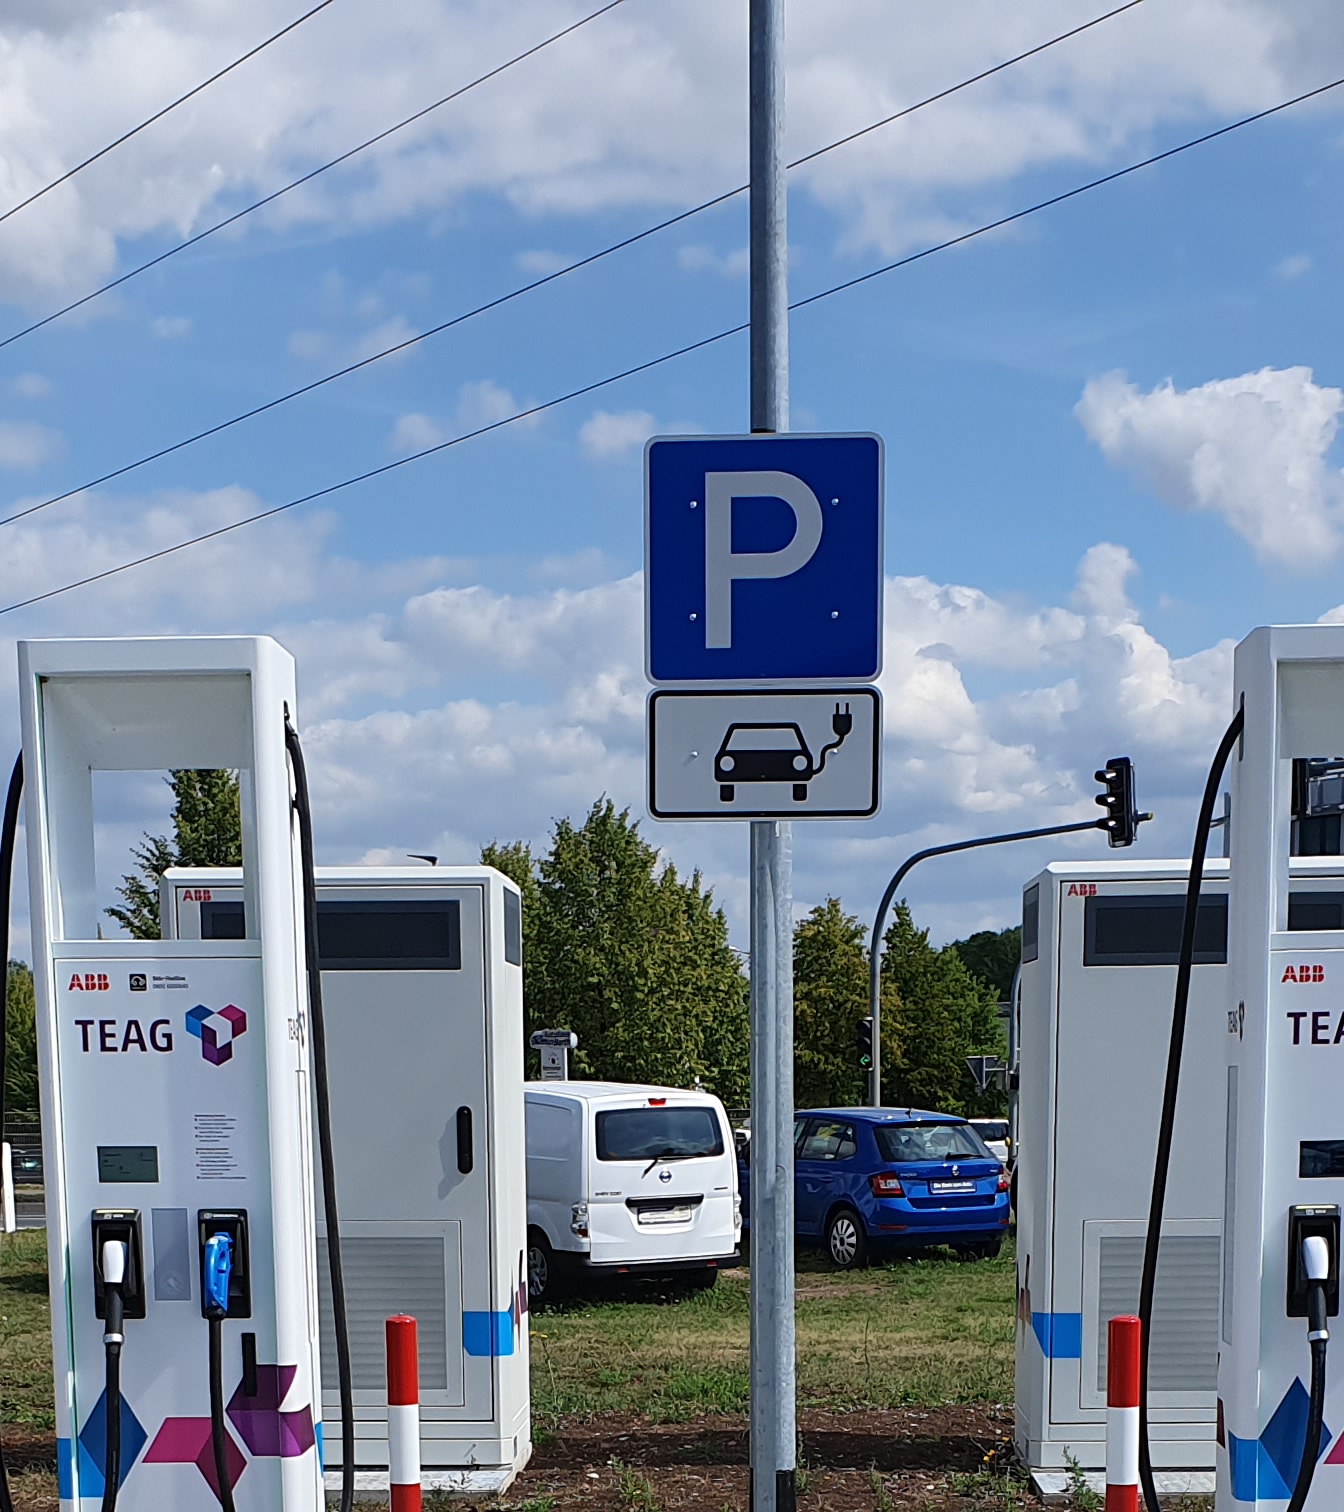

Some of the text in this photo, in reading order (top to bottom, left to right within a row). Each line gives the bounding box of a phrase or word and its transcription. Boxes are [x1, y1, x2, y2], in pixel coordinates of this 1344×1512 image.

[705, 471, 823, 648] P
[183, 889, 212, 901] ABB
[1067, 884, 1097, 896] ABB
[68, 974, 110, 991] ABB
[1281, 965, 1325, 983] ABB
[74, 1019, 174, 1053] TEAG
